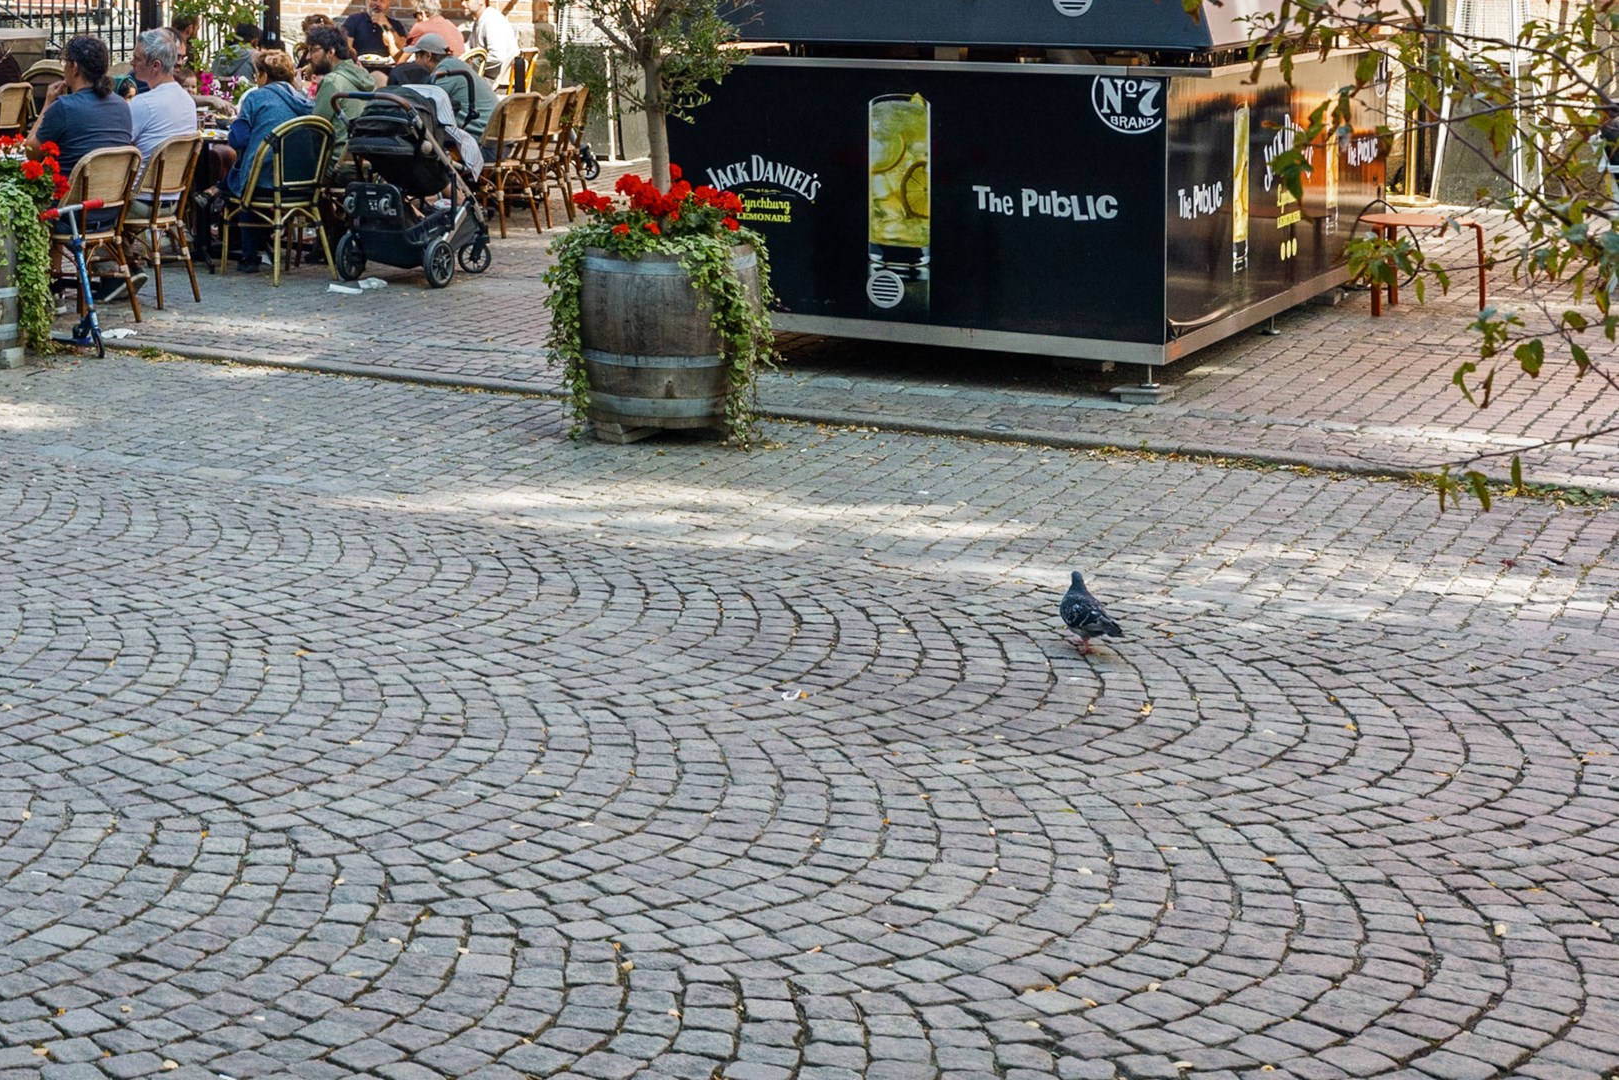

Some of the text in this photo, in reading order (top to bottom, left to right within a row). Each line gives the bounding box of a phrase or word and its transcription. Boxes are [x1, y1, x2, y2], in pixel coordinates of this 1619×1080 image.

[1110, 116, 1155, 129] BRAND
[706, 154, 821, 200] JACK DANIEL'S
[972, 185, 1014, 216] The
[1178, 188, 1192, 220] The
[736, 213, 792, 223] LEMONADE
